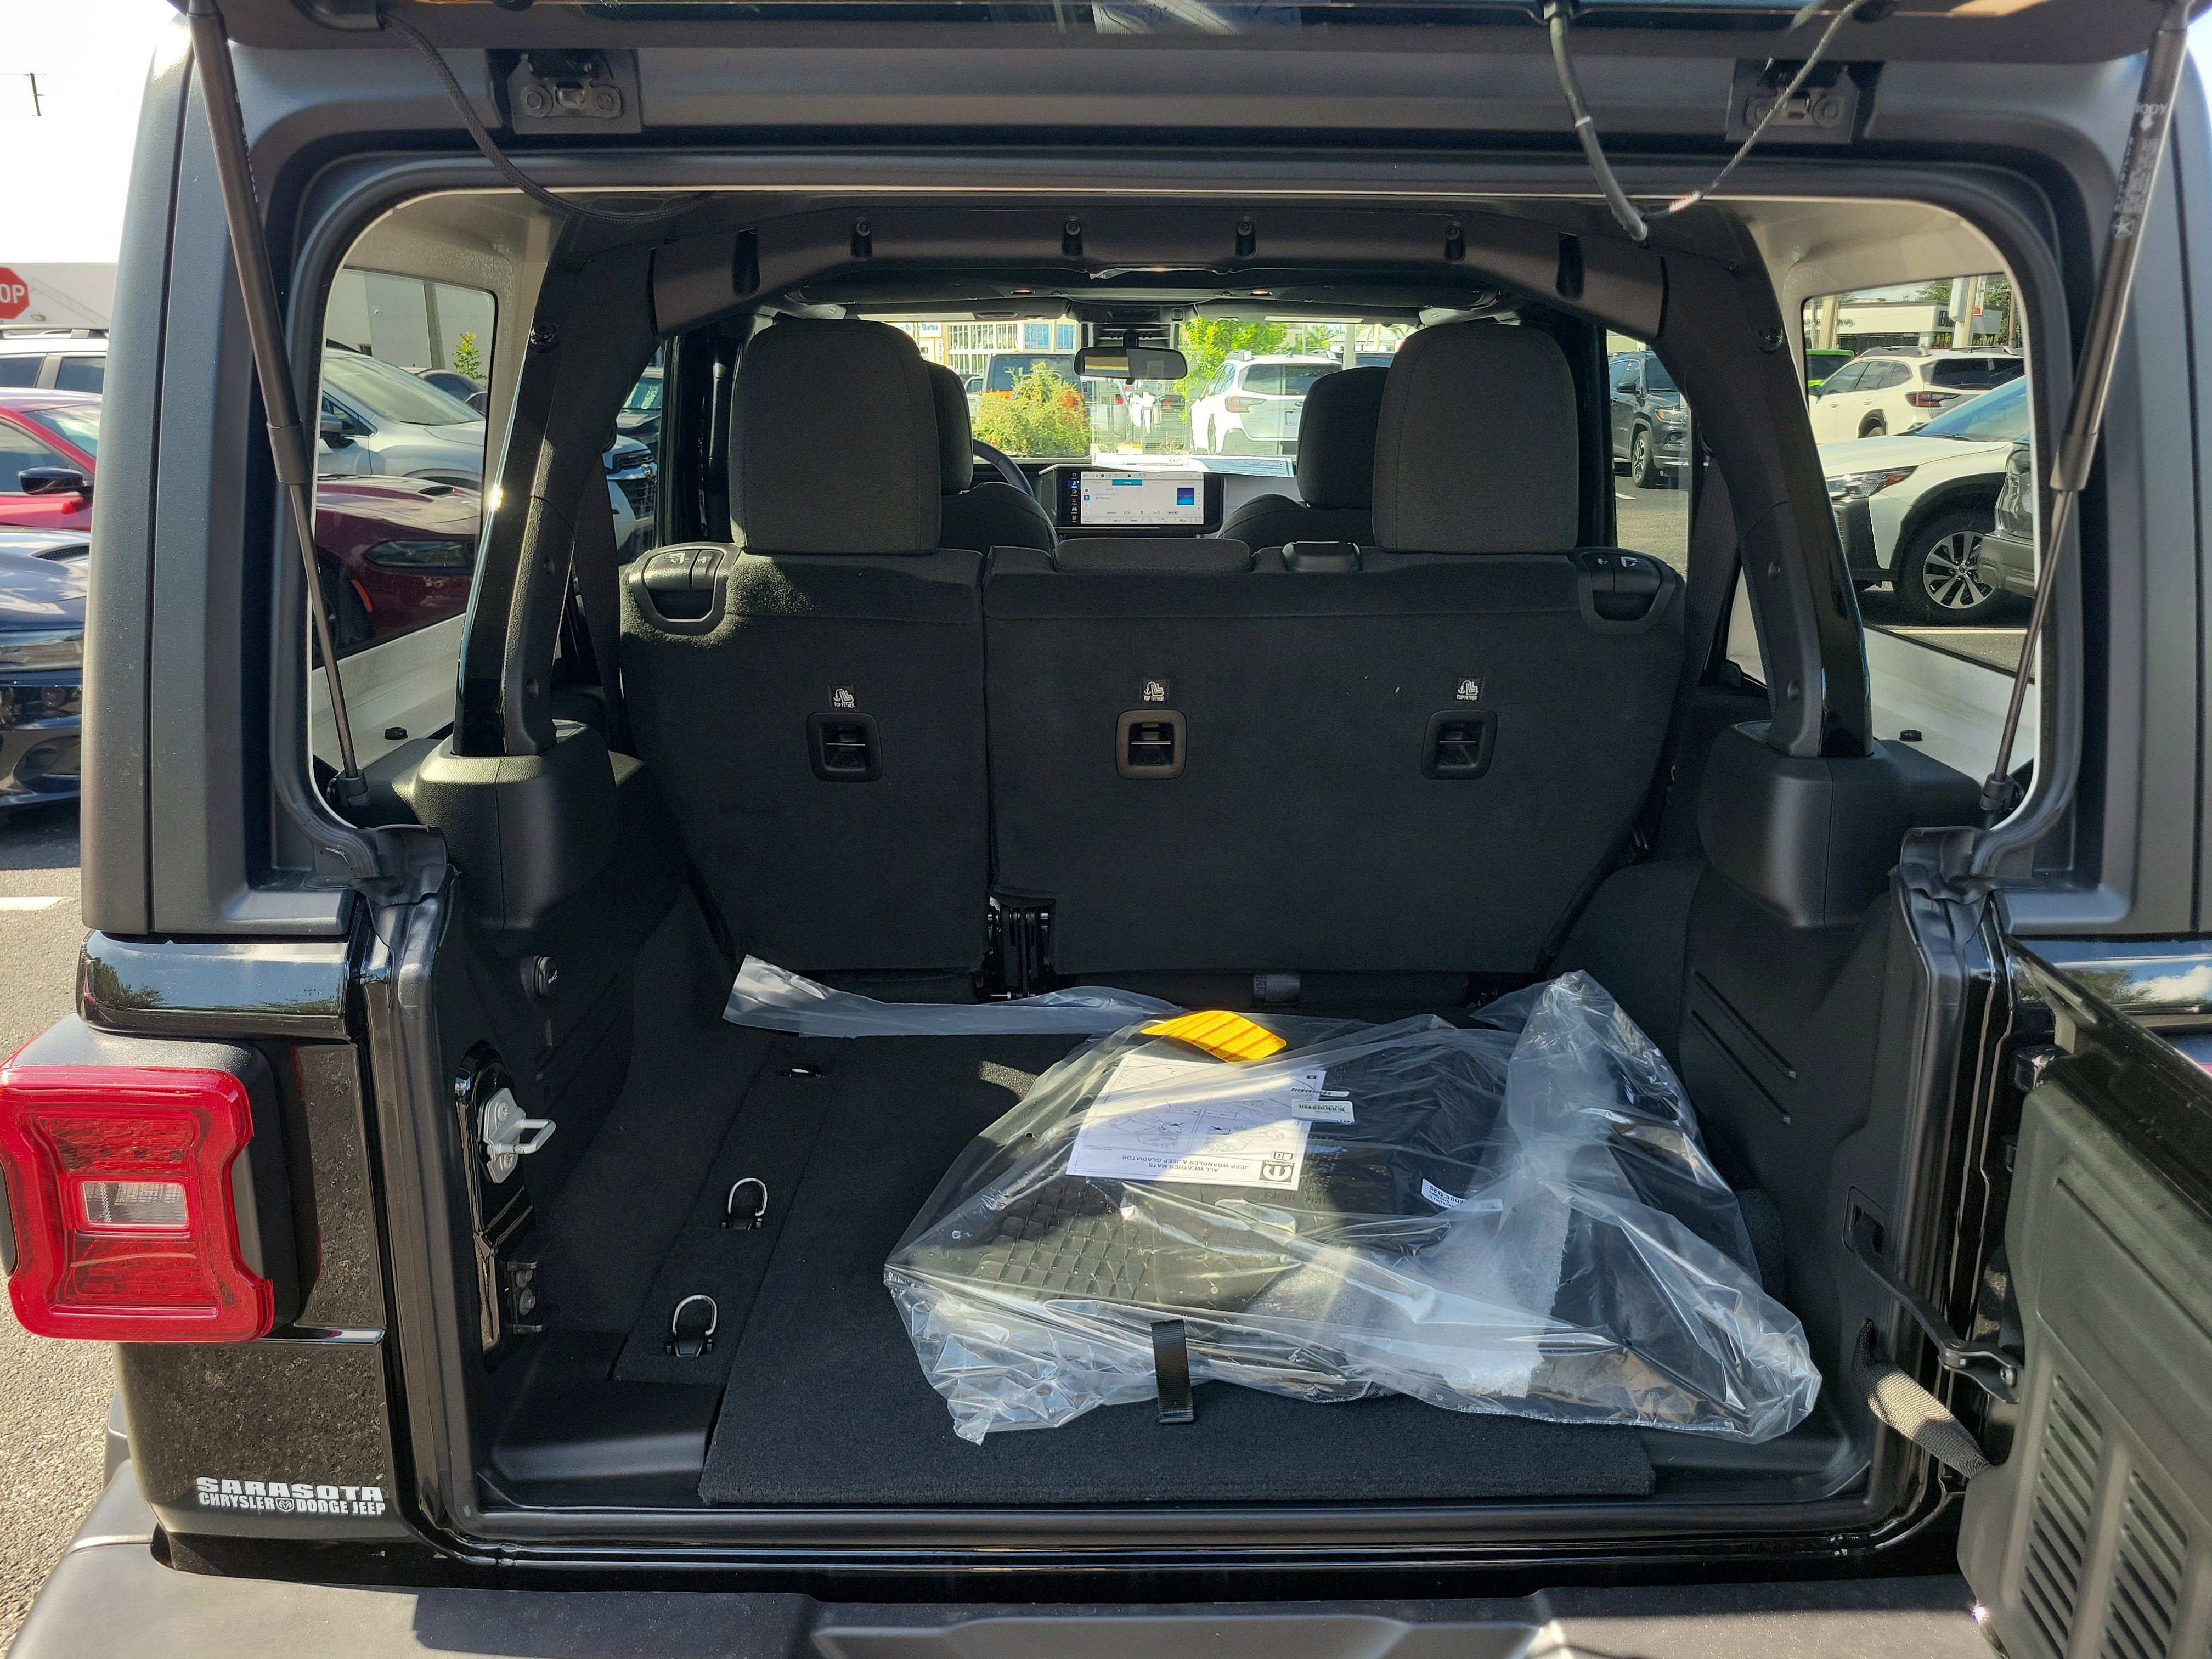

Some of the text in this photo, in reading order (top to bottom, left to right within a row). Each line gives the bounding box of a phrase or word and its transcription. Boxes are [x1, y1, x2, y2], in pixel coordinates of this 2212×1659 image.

[0, 284, 25, 304] OP
[1169, 1164, 1204, 1172] WEATHER
[1189, 1160, 1229, 1169] WRANGLER
[196, 1476, 383, 1502] SARASOTA
[199, 1491, 385, 1515] CHRYSLER DODGE JEEP
